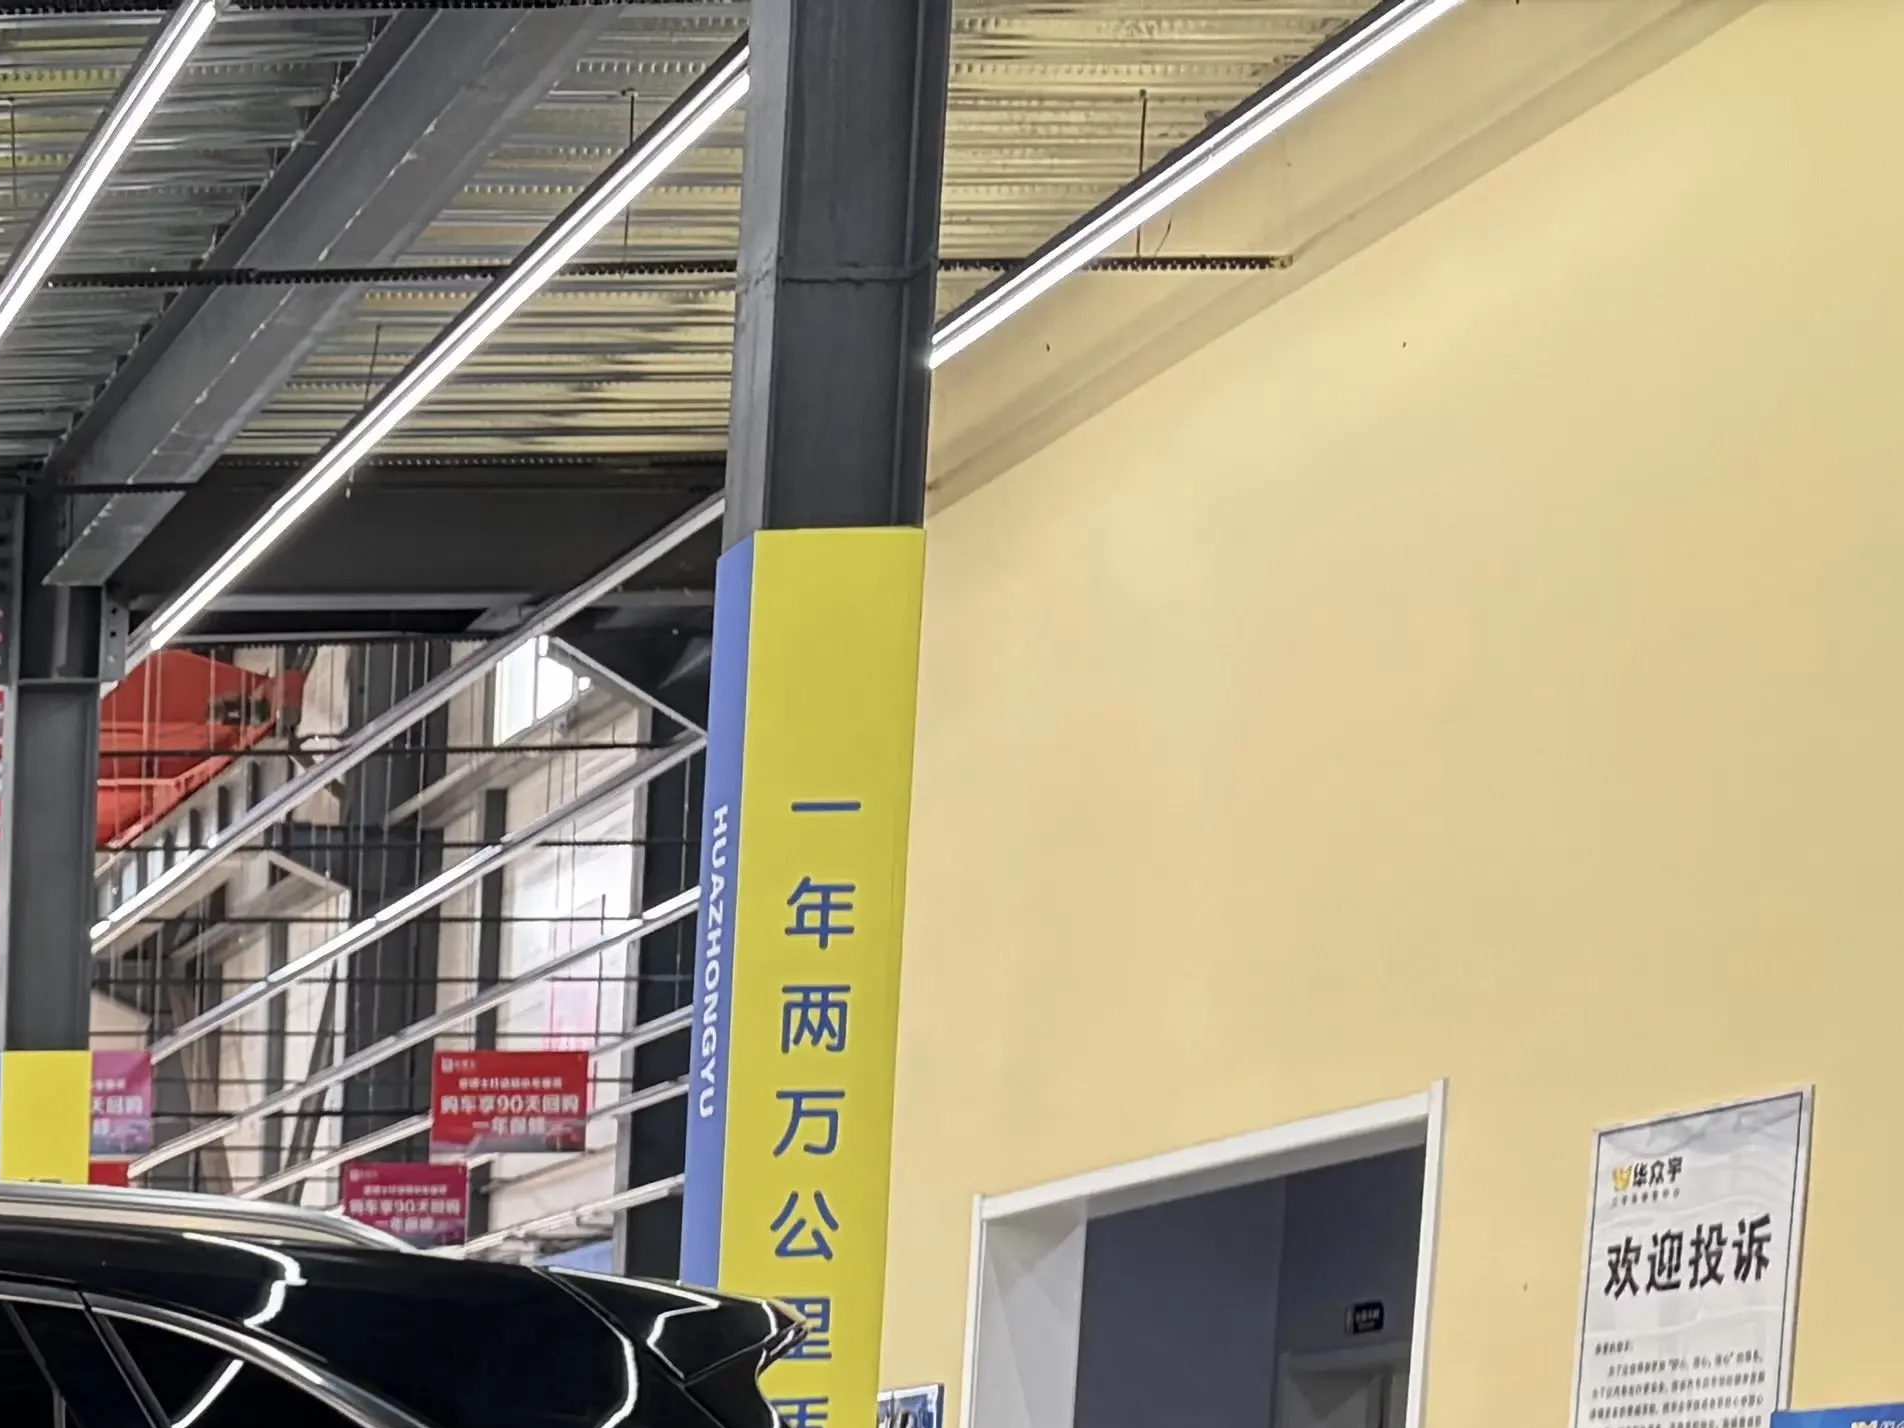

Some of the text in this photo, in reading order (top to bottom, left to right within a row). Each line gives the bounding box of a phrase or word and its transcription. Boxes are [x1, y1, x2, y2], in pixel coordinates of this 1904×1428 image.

[699, 805, 728, 1118] HUAZHONGYU
[1633, 1156, 1683, 1187] 华众宇
[1604, 1213, 1771, 1301] 欢迎投诉
